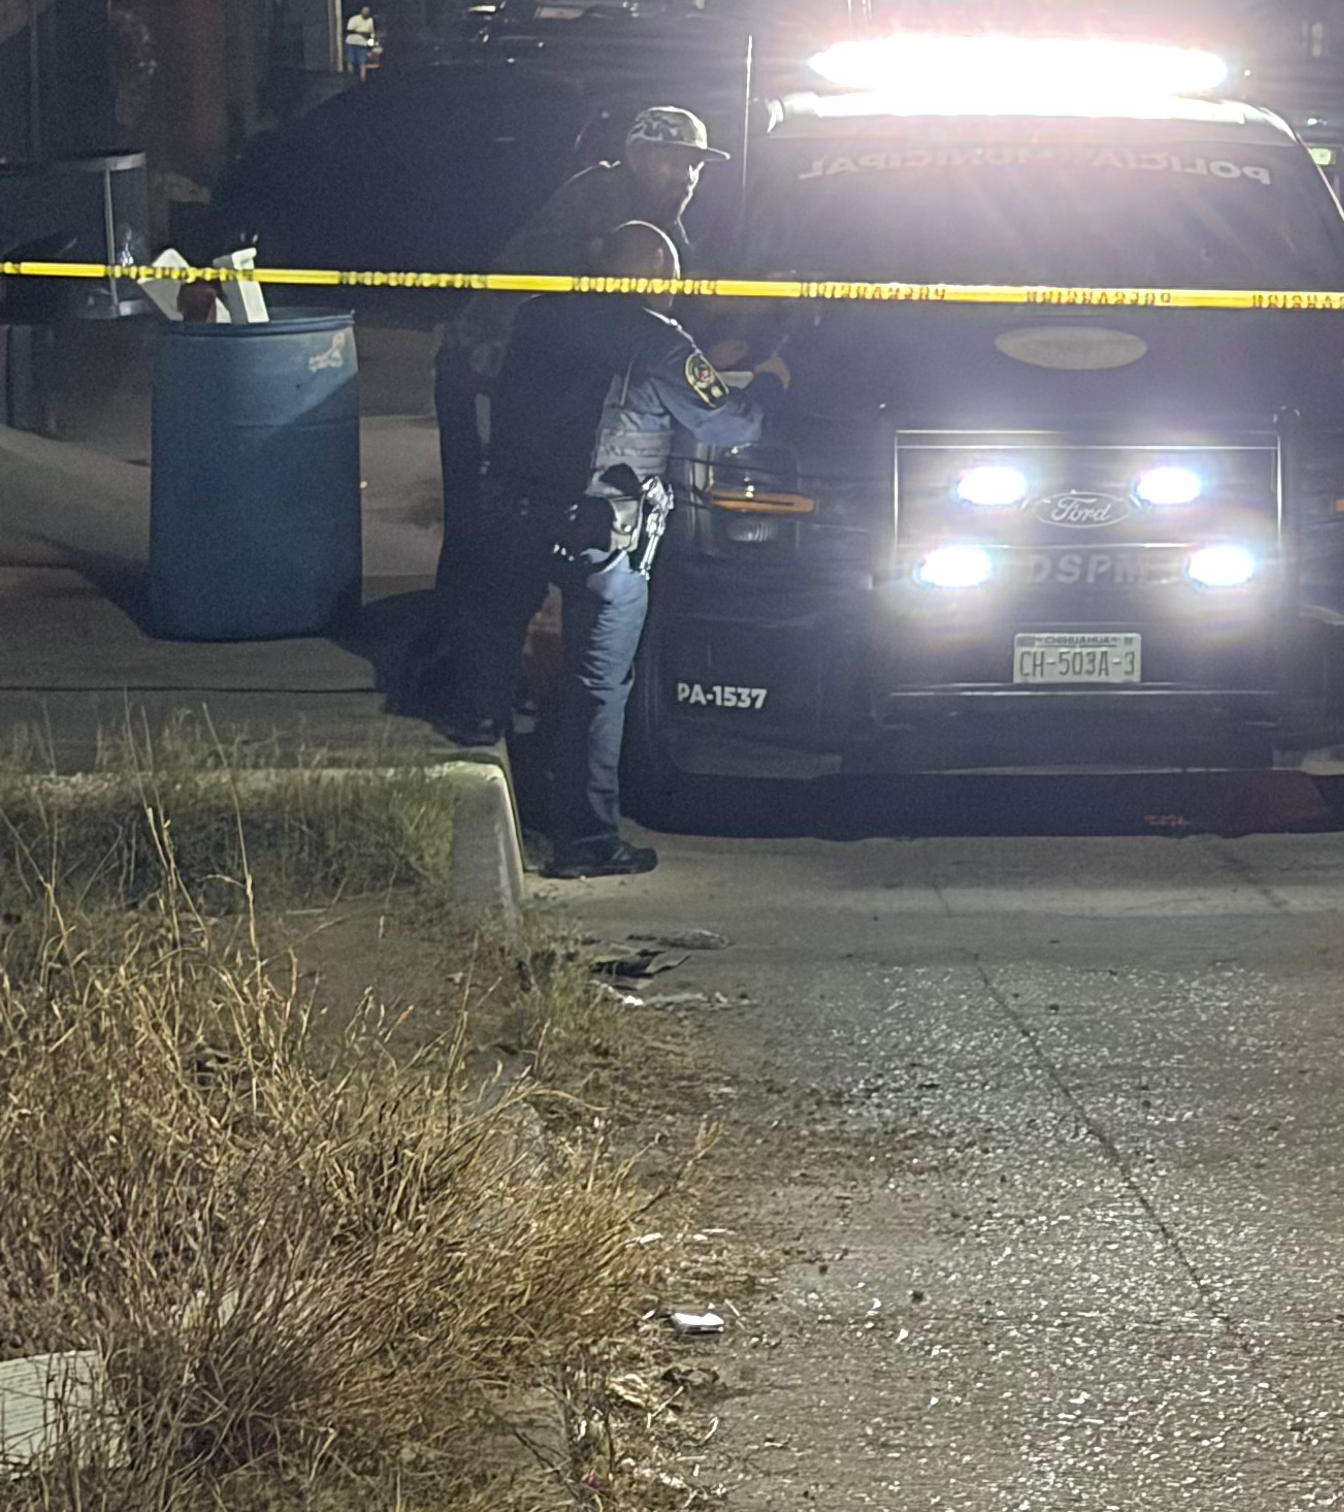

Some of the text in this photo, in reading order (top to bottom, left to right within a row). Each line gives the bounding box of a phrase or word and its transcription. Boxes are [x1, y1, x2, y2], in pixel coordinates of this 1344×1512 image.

[1051, 498, 1112, 522] Ford
[1019, 650, 1136, 678] CH-503A-3
[677, 682, 768, 709] PA-1537
